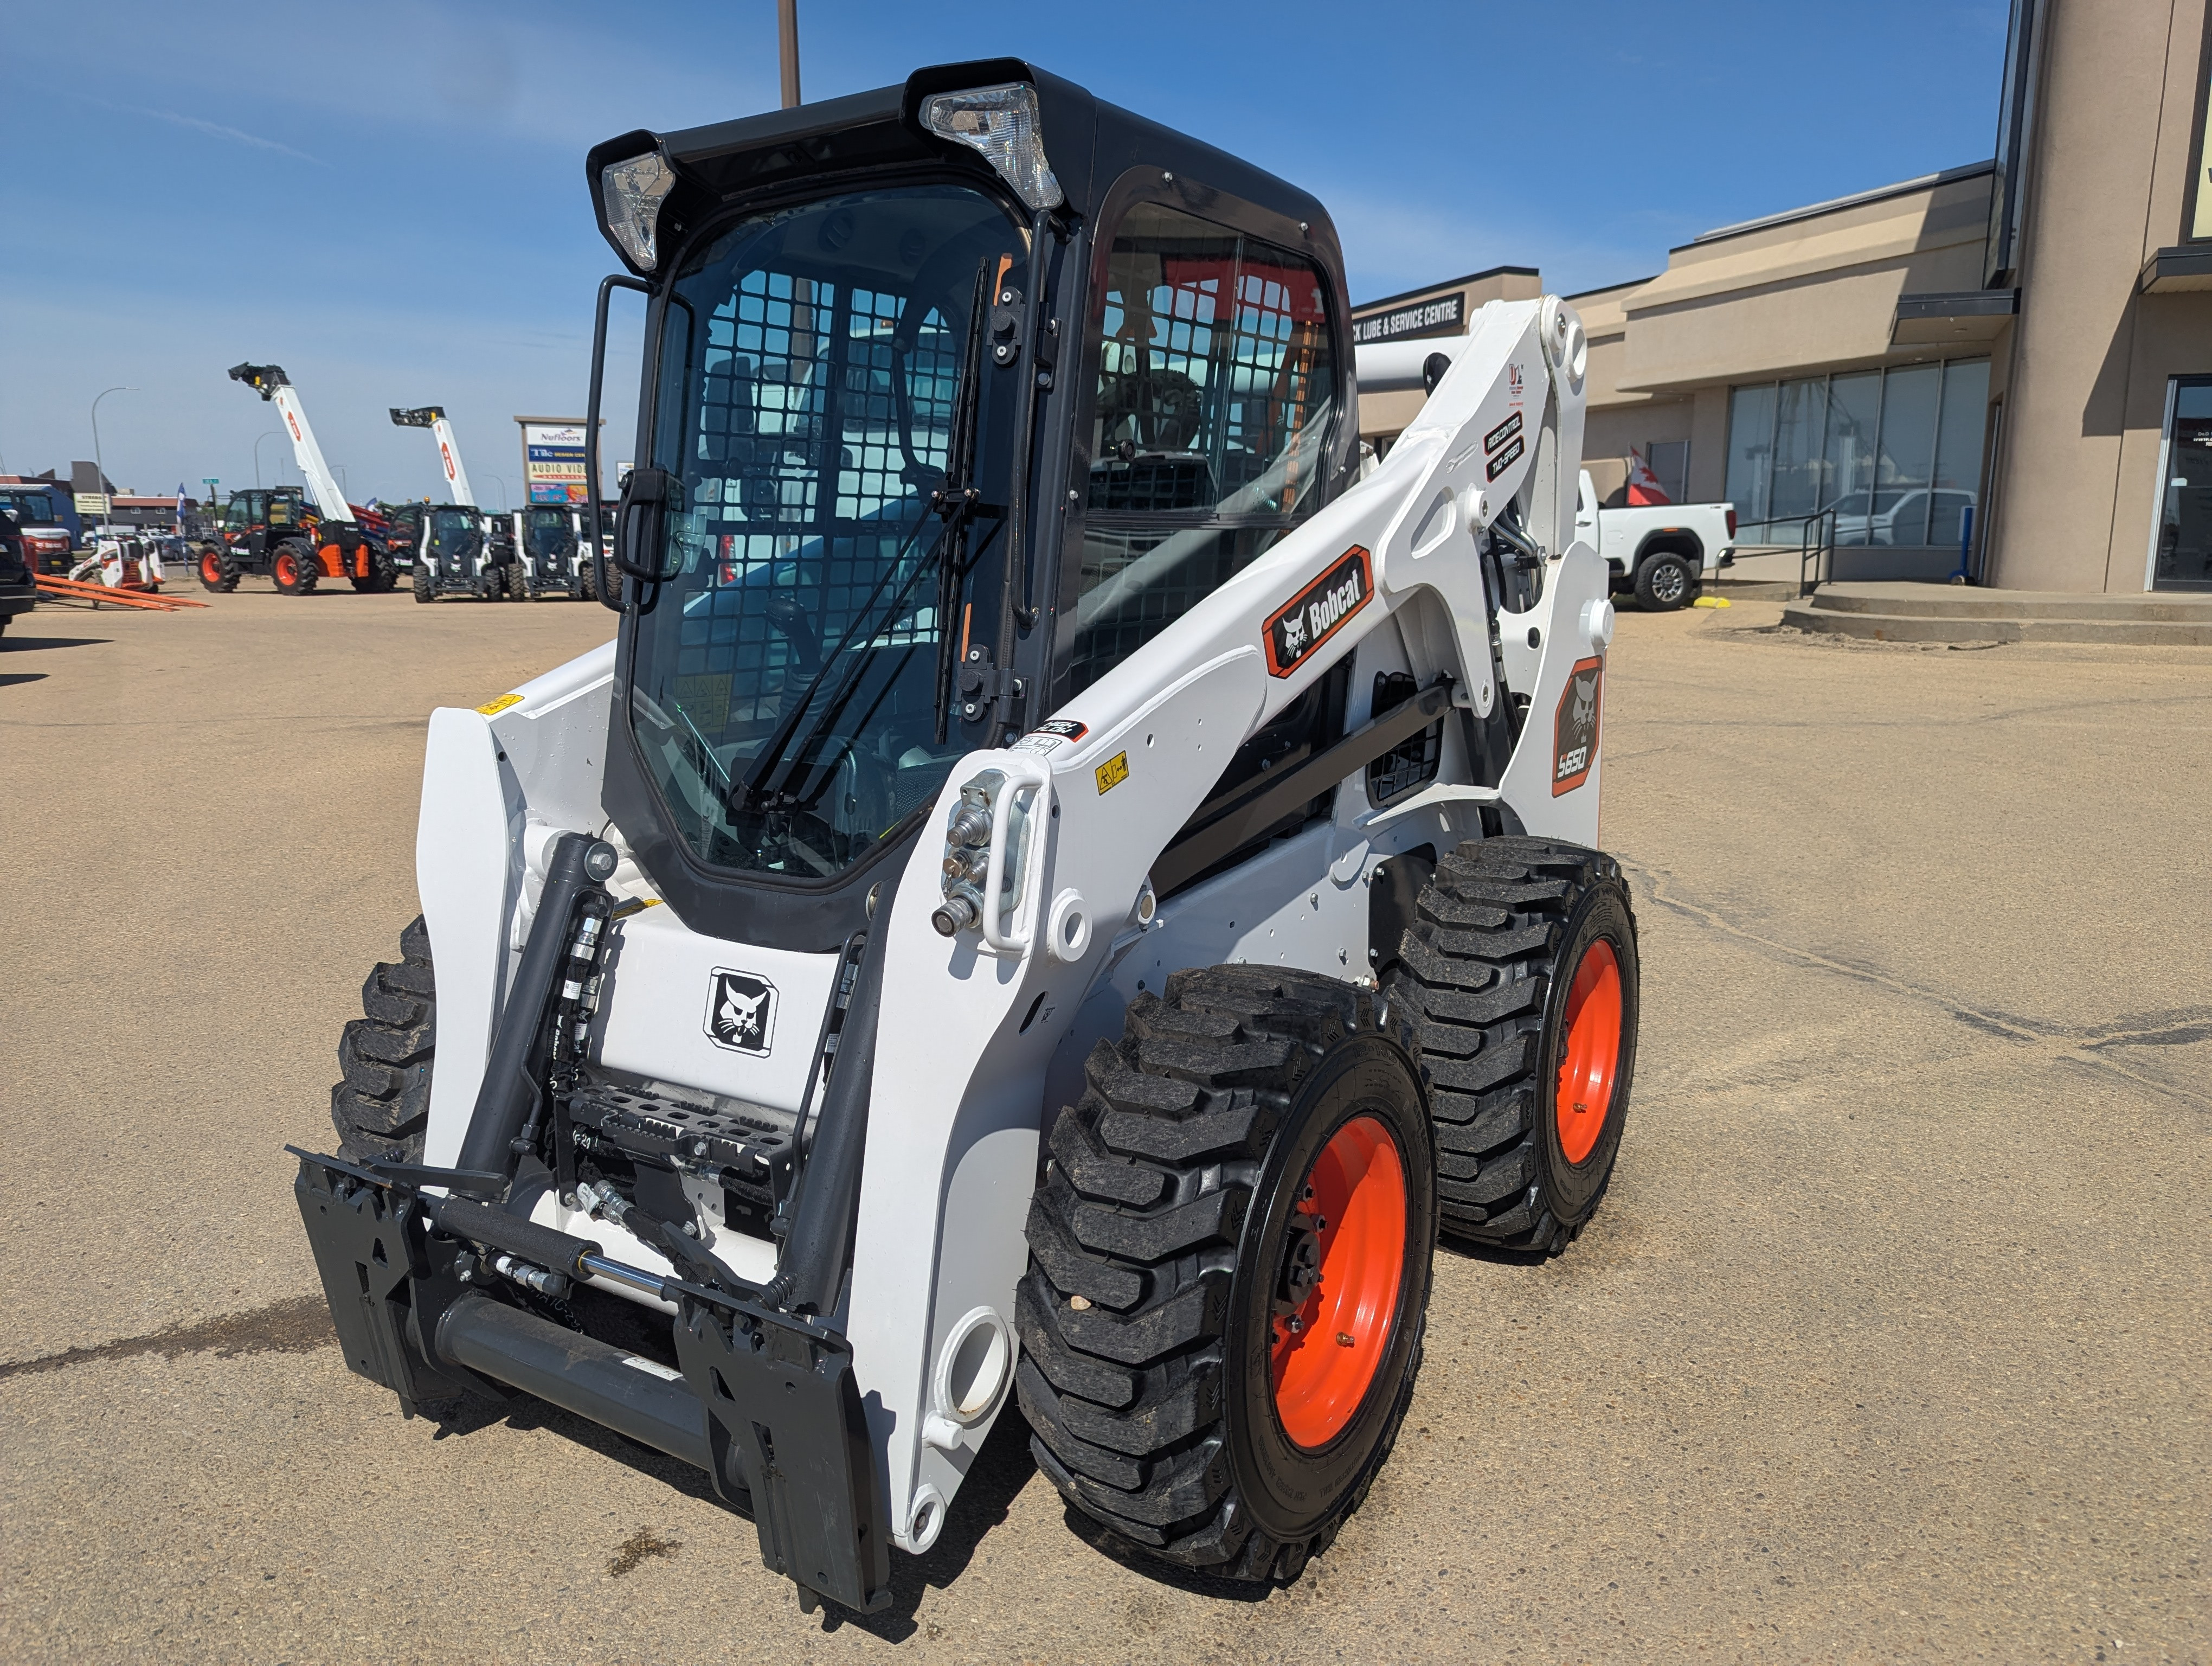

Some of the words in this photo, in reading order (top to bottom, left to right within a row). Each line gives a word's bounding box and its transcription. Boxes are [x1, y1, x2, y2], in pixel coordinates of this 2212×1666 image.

[1363, 318, 1382, 341] LUBE
[1383, 316, 1390, 335] &
[1390, 307, 1423, 334] SERVICE
[1424, 299, 1458, 326] CENTRE
[1499, 415, 1521, 441] CONTROL
[532, 464, 562, 473] AUDIO
[1493, 441, 1520, 475] TWO-SPEED
[1309, 568, 1360, 640] Bobcat
[1557, 746, 1587, 778] S650
